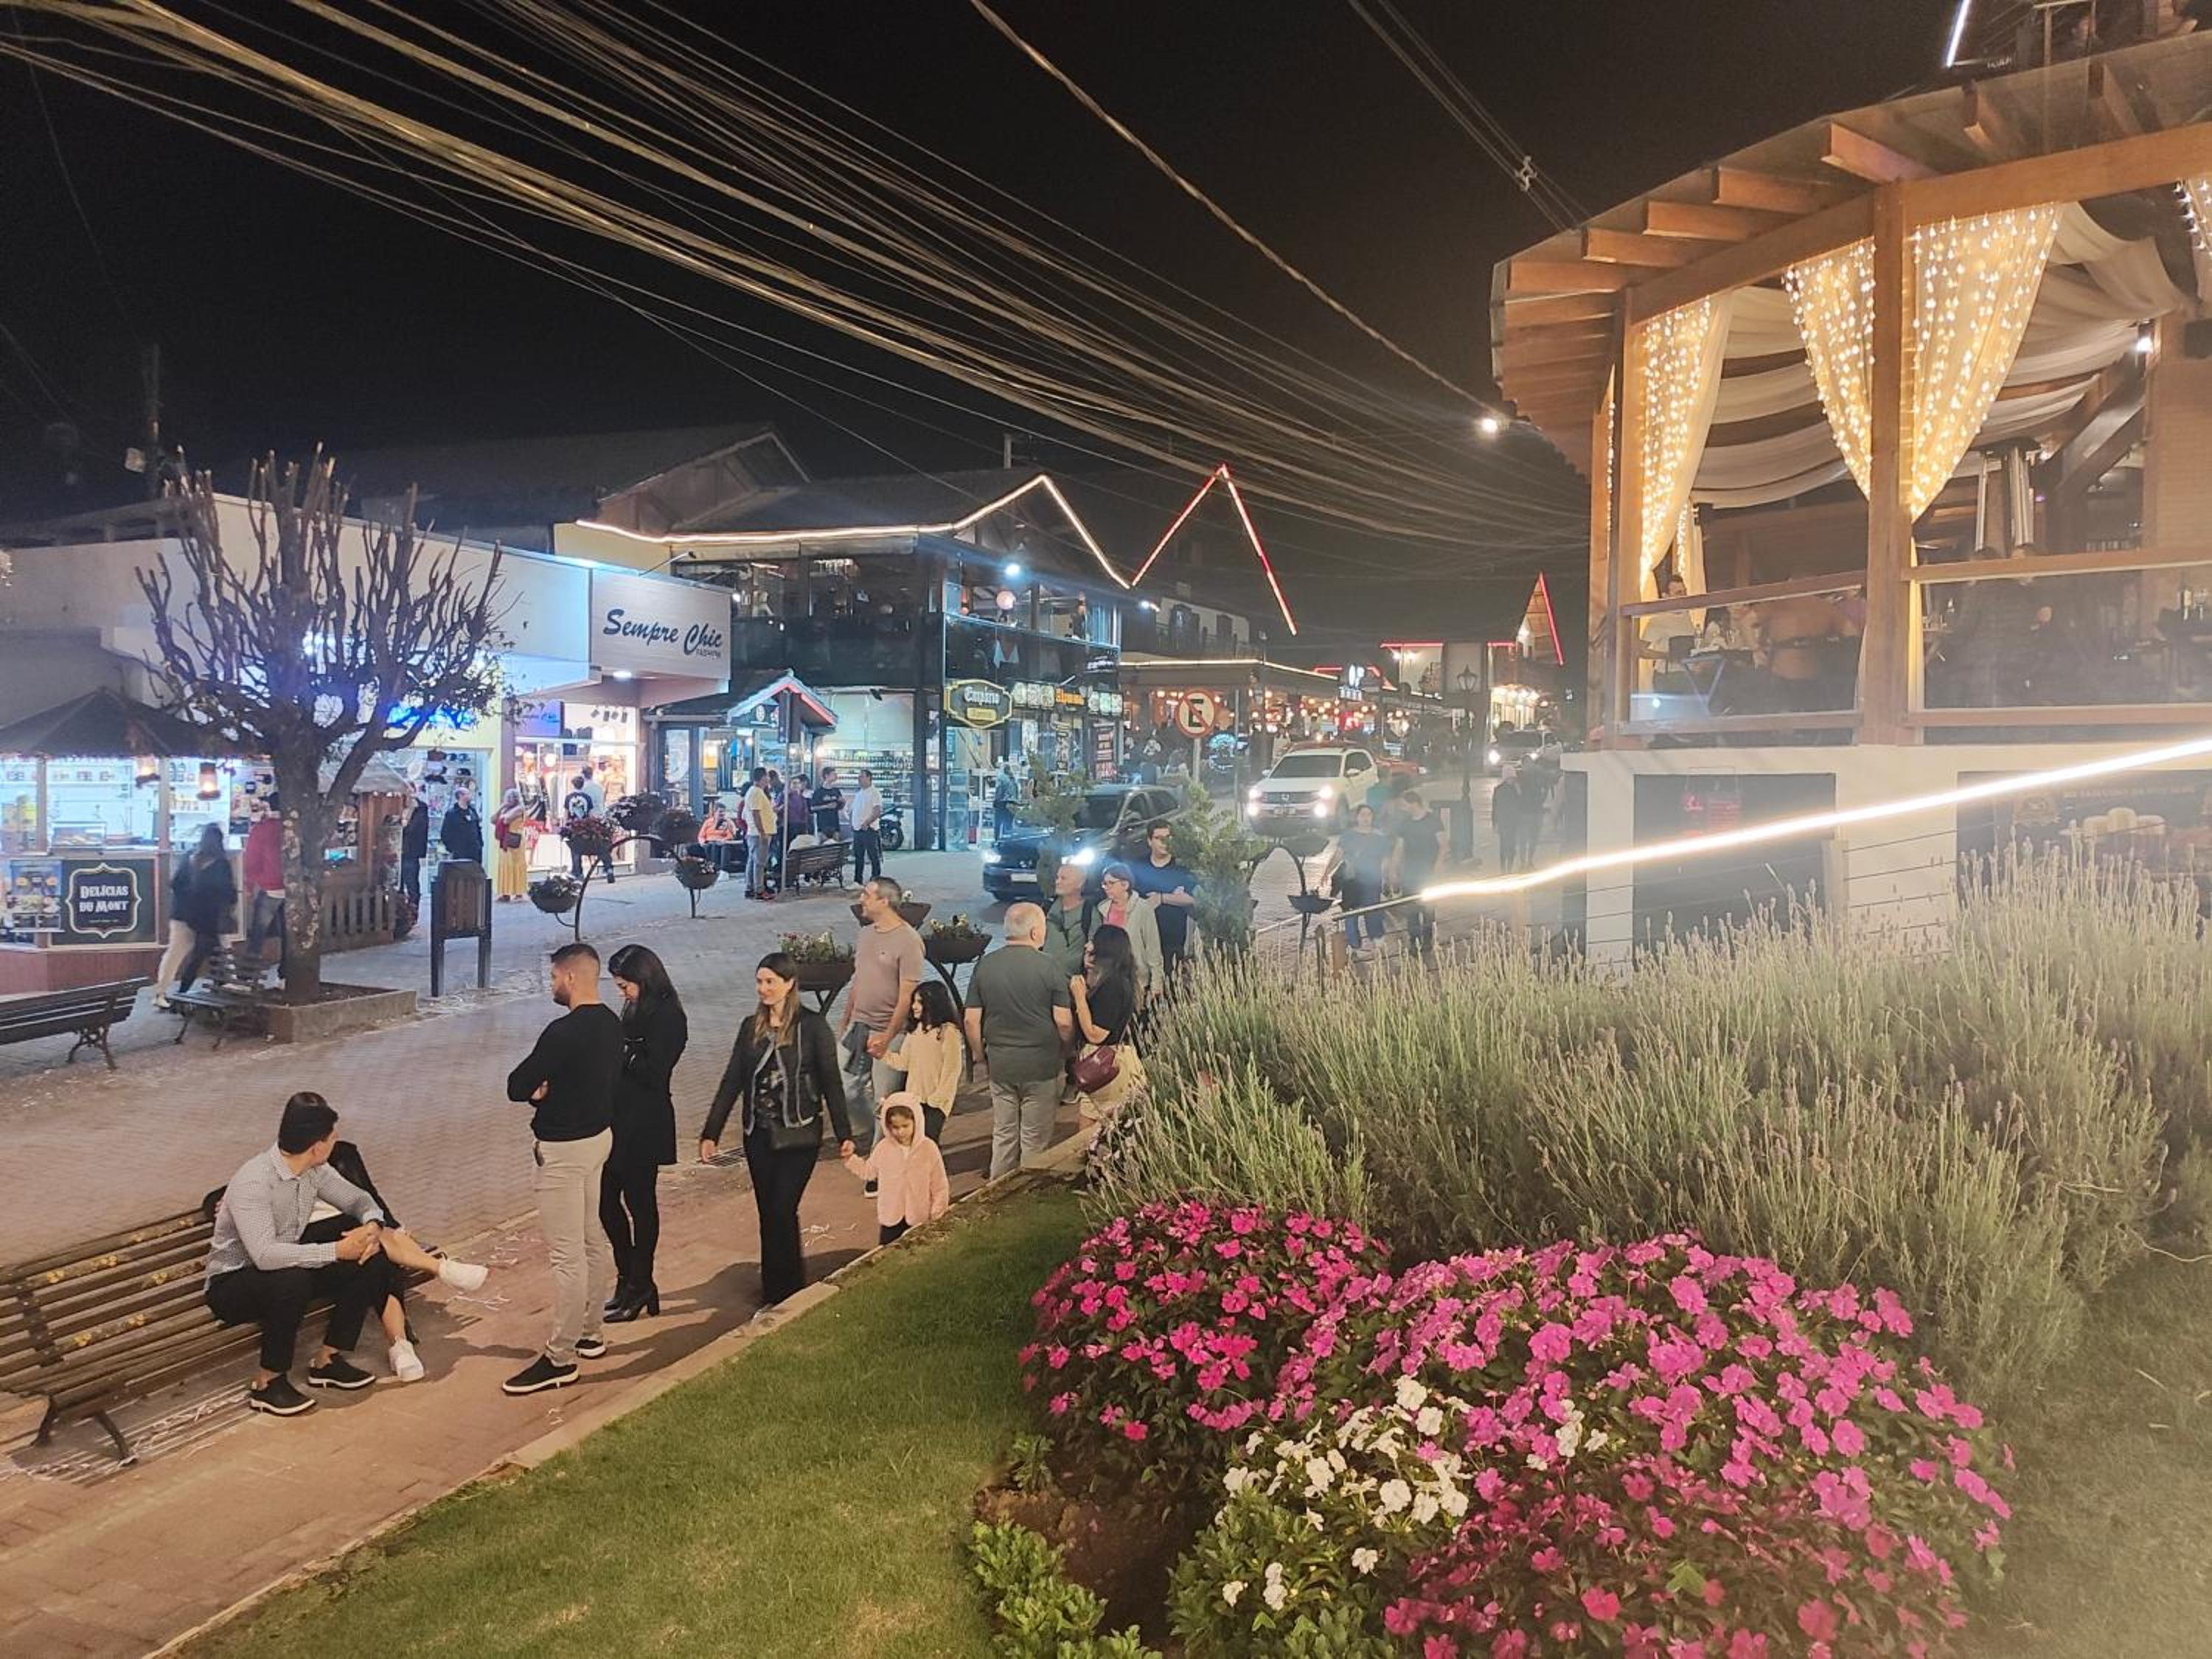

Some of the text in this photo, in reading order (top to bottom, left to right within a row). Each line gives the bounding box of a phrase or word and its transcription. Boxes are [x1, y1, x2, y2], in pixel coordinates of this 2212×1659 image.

[603, 608, 722, 655] Sempre Chic
[79, 900, 129, 913] DU MONT
